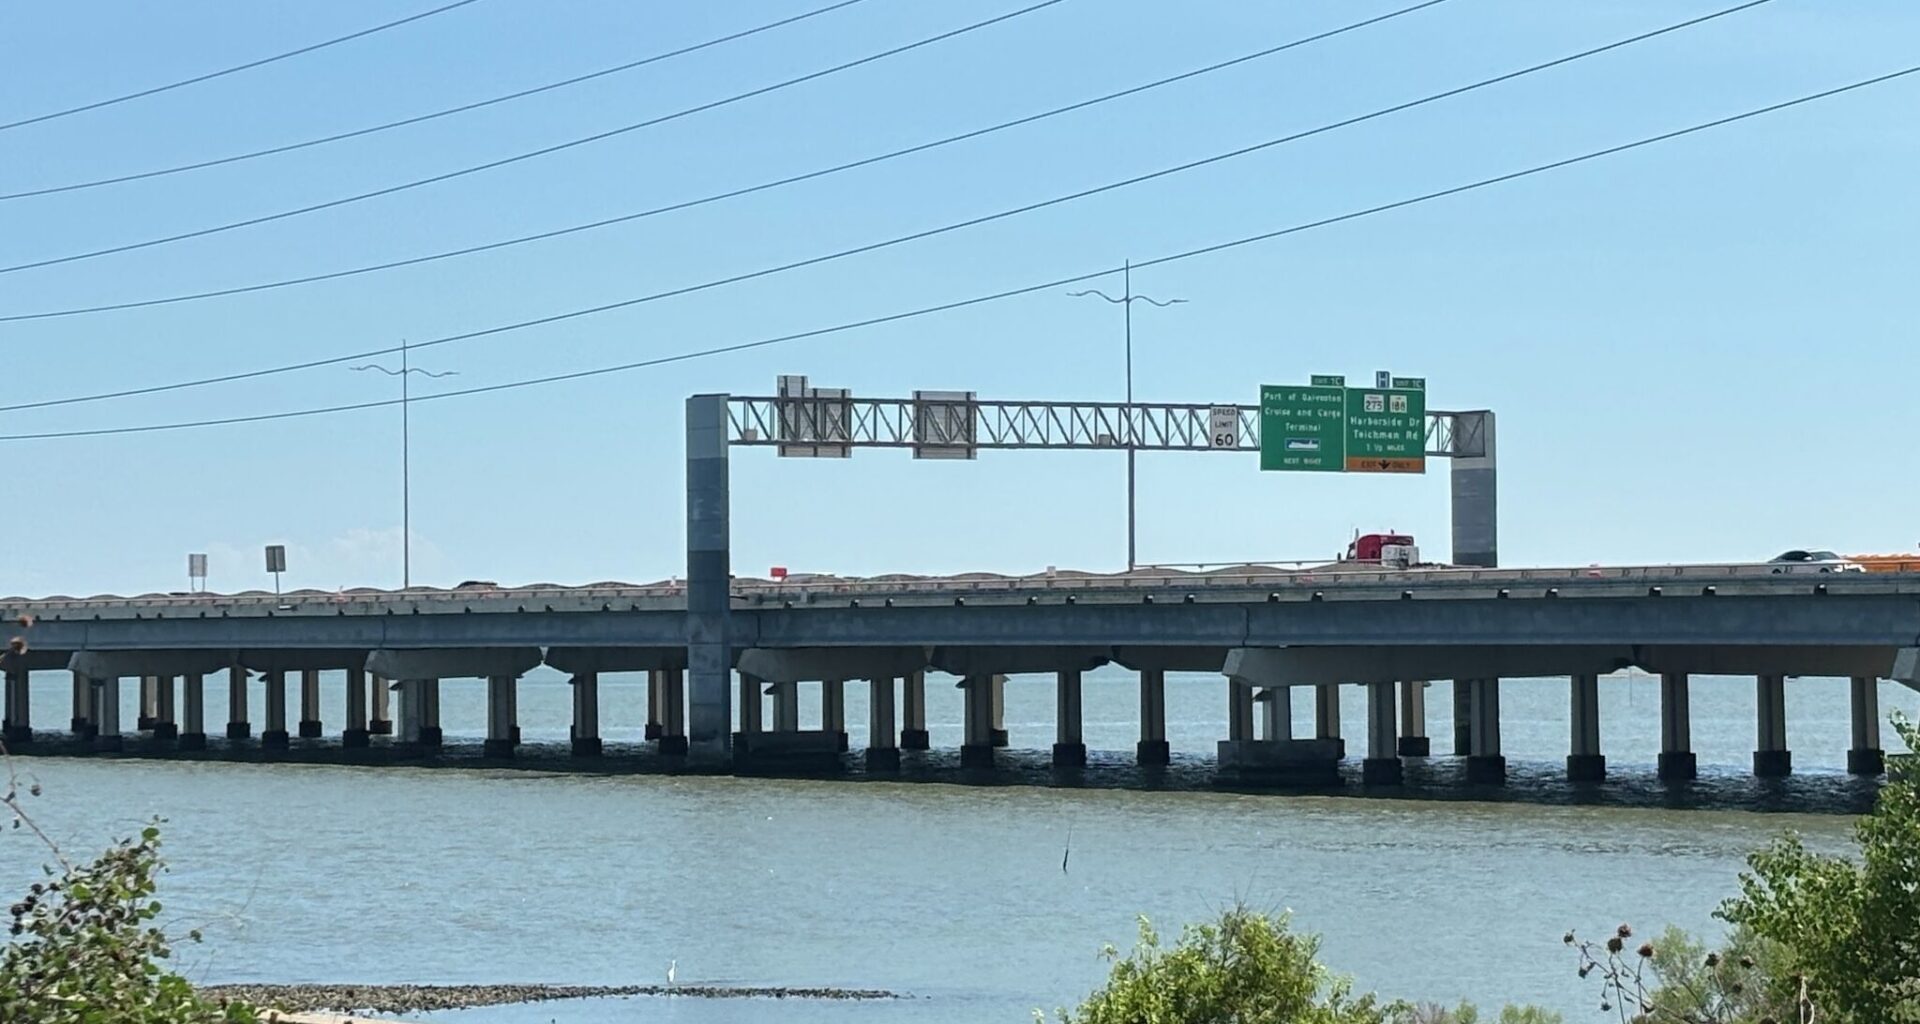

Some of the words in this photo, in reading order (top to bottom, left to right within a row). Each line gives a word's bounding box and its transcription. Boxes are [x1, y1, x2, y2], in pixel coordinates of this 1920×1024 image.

[1377, 371, 1389, 388] H
[1263, 392, 1281, 400] Port
[1288, 393, 1296, 401] of
[1365, 400, 1383, 411] 275
[1213, 408, 1236, 416] SPEED
[1264, 407, 1290, 416] Cruise
[1297, 408, 1312, 417] and
[1317, 408, 1341, 420] Cargo
[1285, 422, 1321, 432] Terminal
[1350, 416, 1402, 426] Harborside
[1409, 417, 1420, 427] Dr
[1215, 433, 1234, 447] 60
[1354, 429, 1400, 440] Teichman
[1406, 430, 1418, 440] Rd
